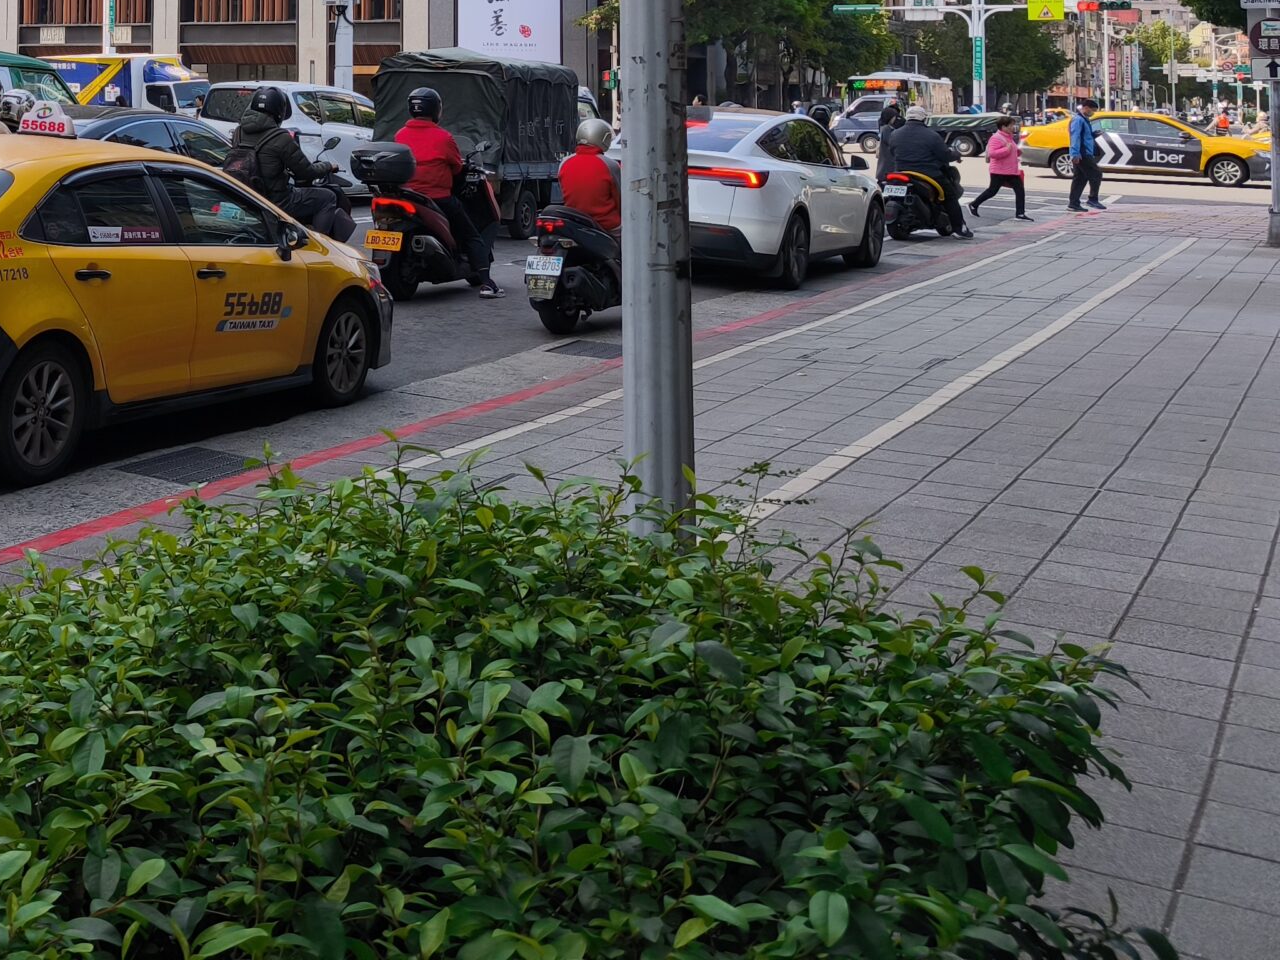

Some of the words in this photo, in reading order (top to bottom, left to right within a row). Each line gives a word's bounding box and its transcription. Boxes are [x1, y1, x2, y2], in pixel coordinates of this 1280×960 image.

[22, 119, 66, 133] 55688
[1144, 150, 1184, 164] Uber
[366, 235, 401, 246] LBD-3237
[223, 292, 284, 317] 55688
[228, 320, 257, 330] TAIWAN
[258, 320, 274, 329] TAXI
